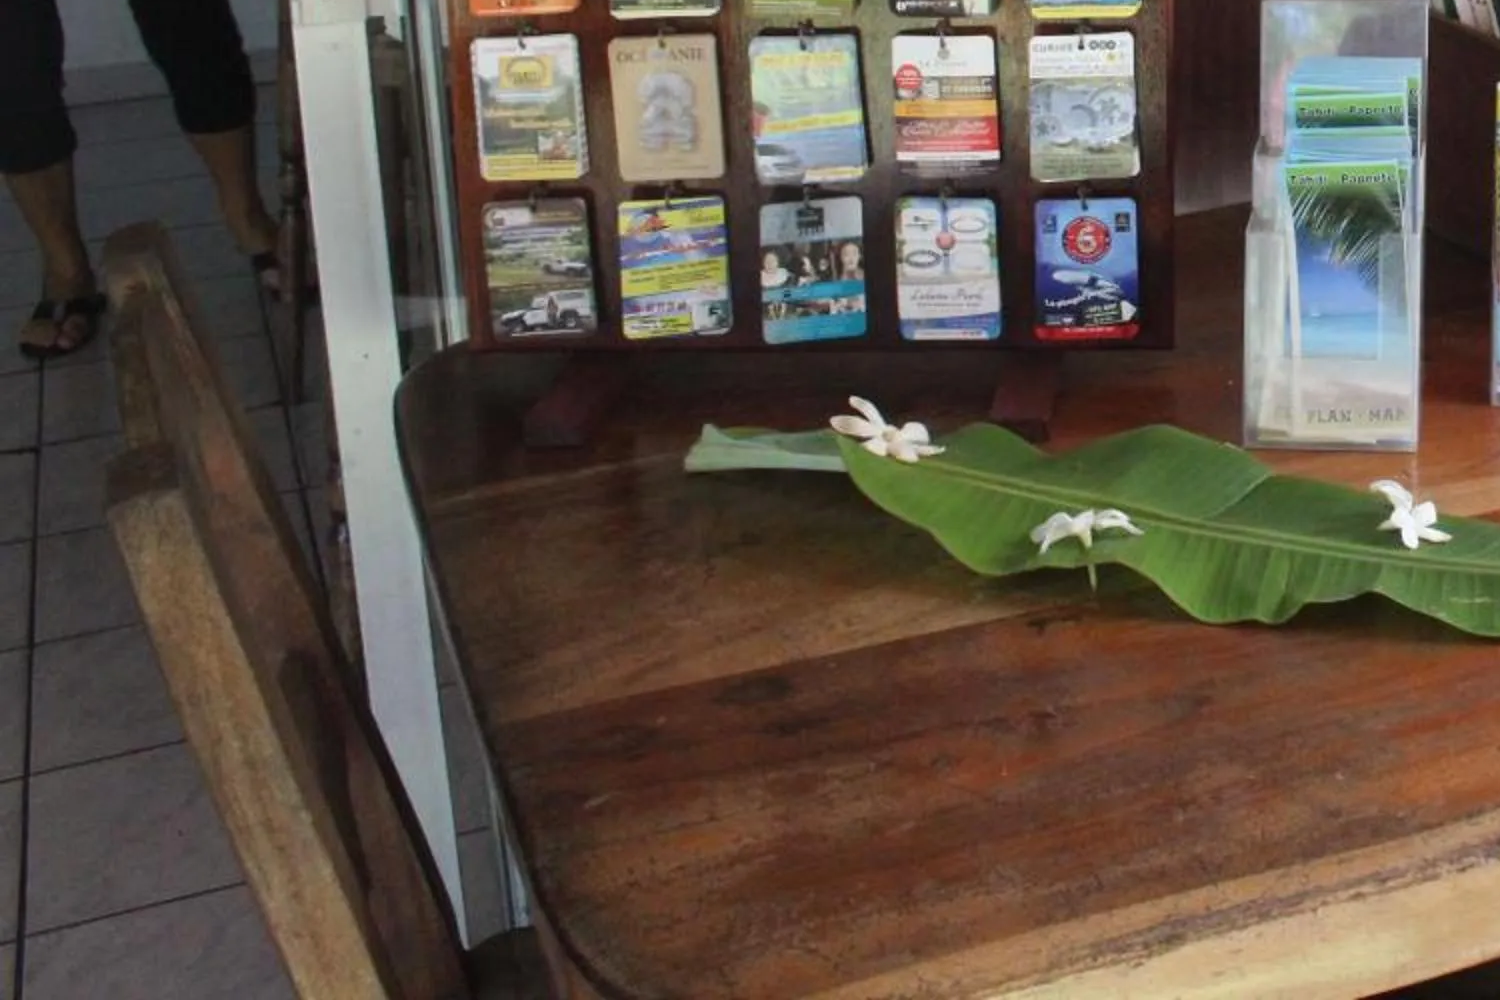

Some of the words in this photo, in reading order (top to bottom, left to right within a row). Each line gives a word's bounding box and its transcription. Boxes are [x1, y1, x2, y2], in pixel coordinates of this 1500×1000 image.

[1290, 174, 1328, 186] Tahiti
[1341, 173, 1397, 187] Papeete
[1306, 409, 1353, 425] PLAN
[1368, 407, 1409, 423] MAP
